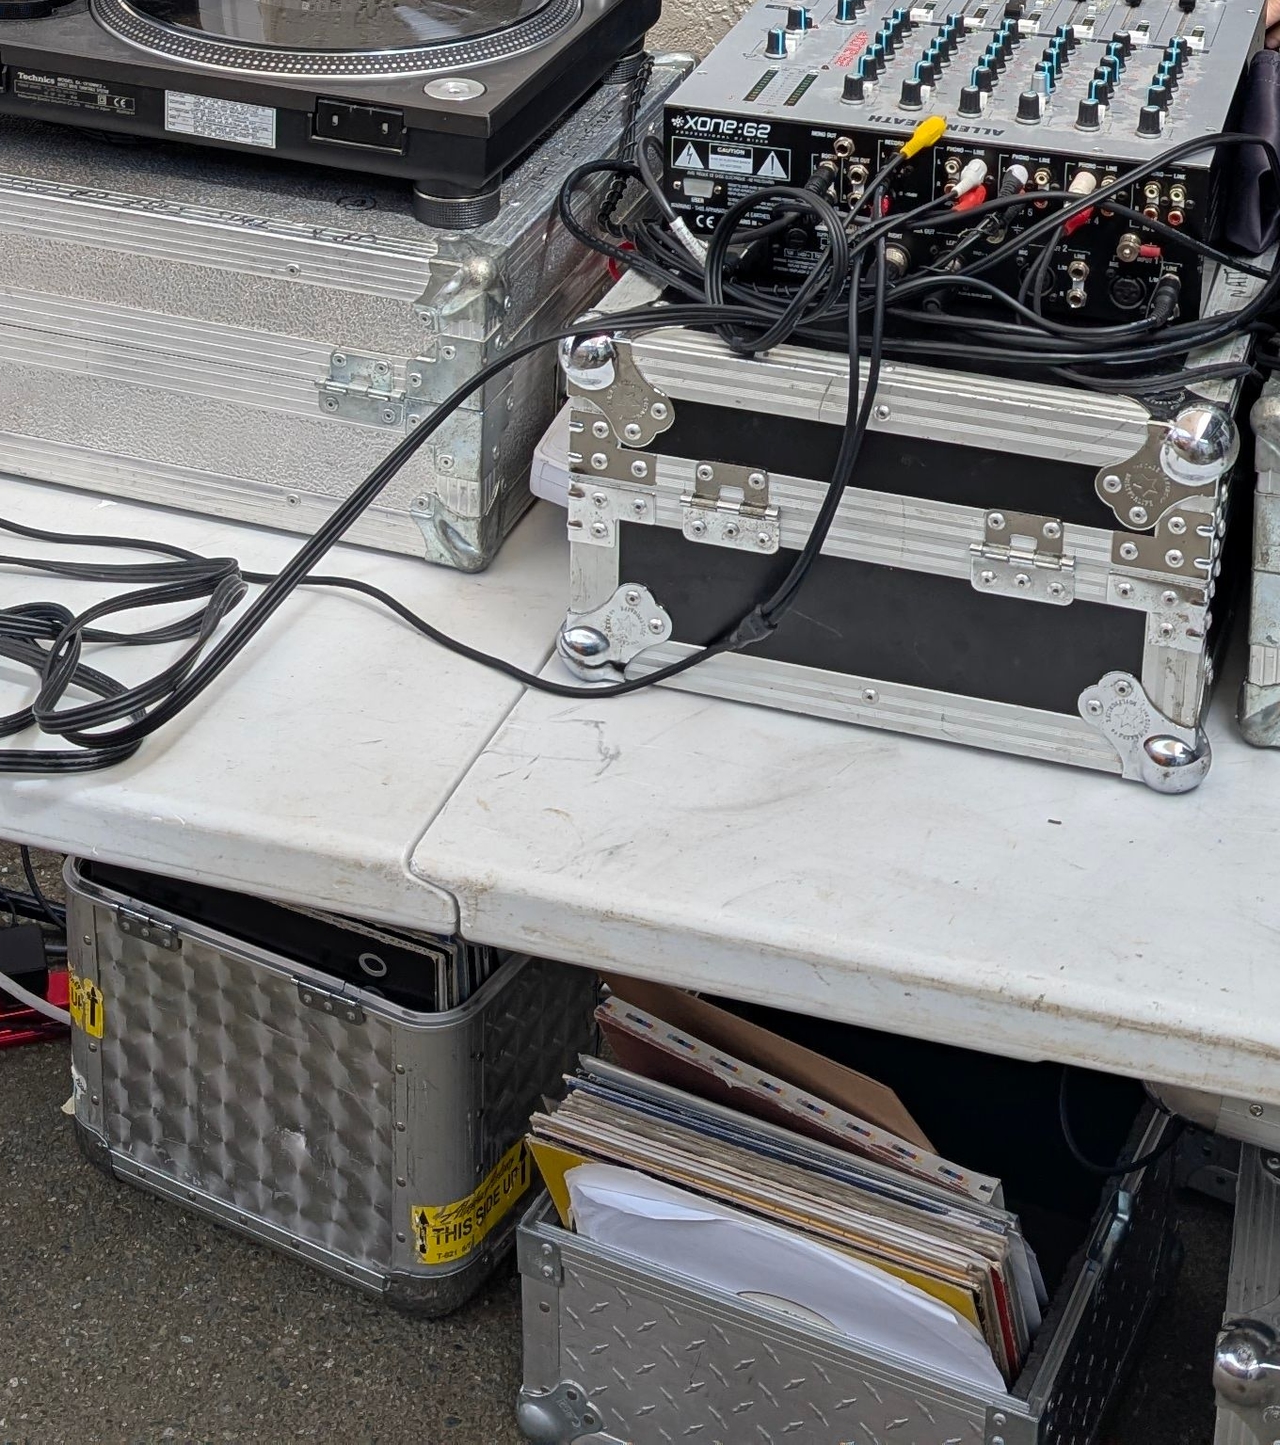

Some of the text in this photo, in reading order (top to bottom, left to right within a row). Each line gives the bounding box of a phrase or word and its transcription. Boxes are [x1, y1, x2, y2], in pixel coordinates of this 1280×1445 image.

[17, 72, 55, 84] Technics
[948, 124, 1005, 138] ALLEN
[717, 146, 745, 155] CAUTION
[432, 1217, 473, 1245] THIS
[475, 1185, 501, 1227] SIDE
